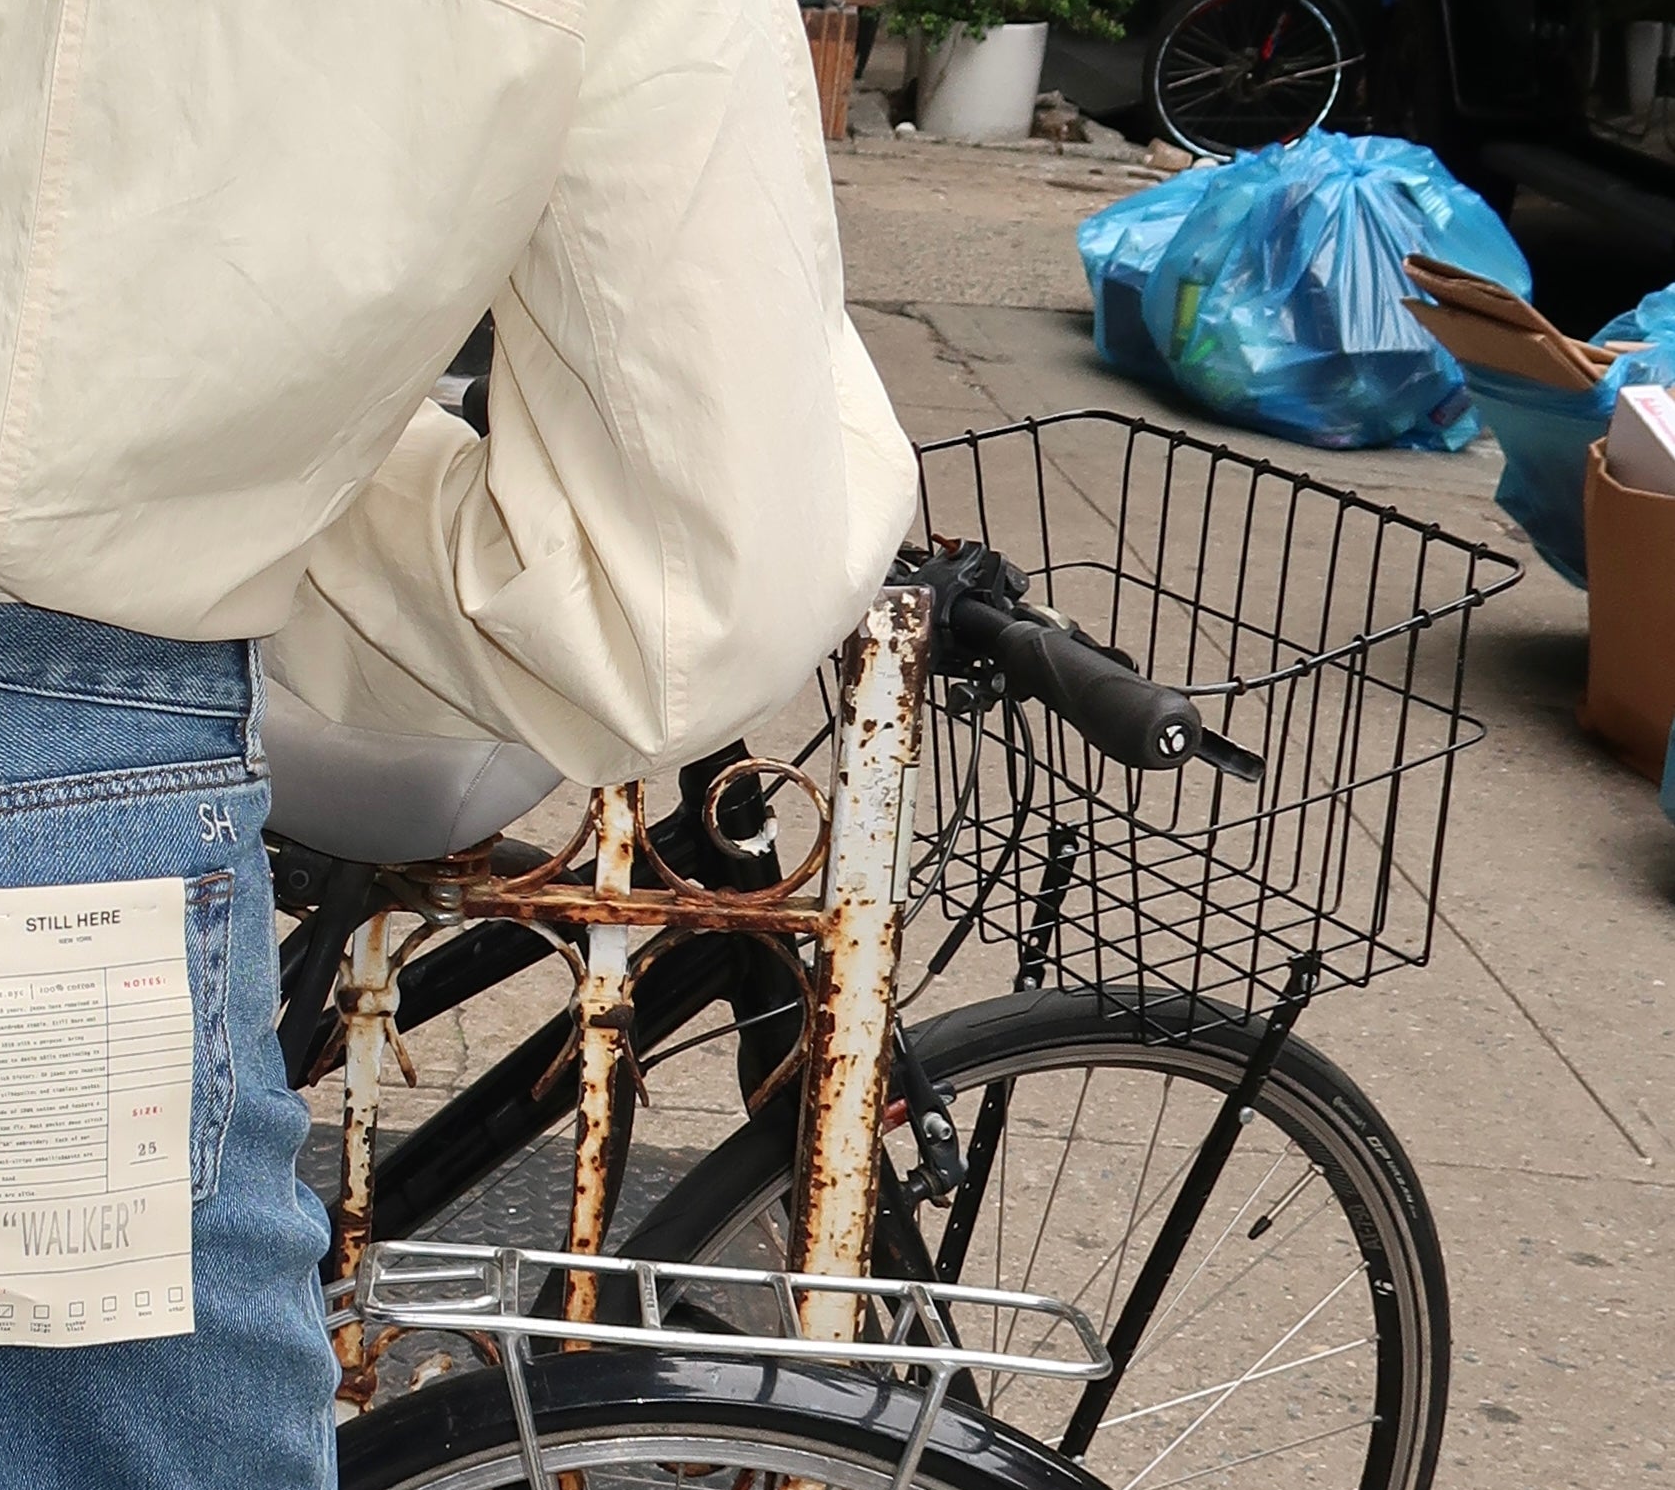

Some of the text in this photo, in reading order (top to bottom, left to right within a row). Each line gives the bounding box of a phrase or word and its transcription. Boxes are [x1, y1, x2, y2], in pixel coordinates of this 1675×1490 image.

[198, 802, 237, 843] SH
[26, 909, 121, 932] STILL HERE
[59, 935, 92, 944] NEW YORK
[124, 976, 167, 988] NOTES:
[132, 1106, 163, 1117] SIZE:
[138, 1141, 156, 1157] 25
[3, 1199, 147, 1257] “WALKER”
